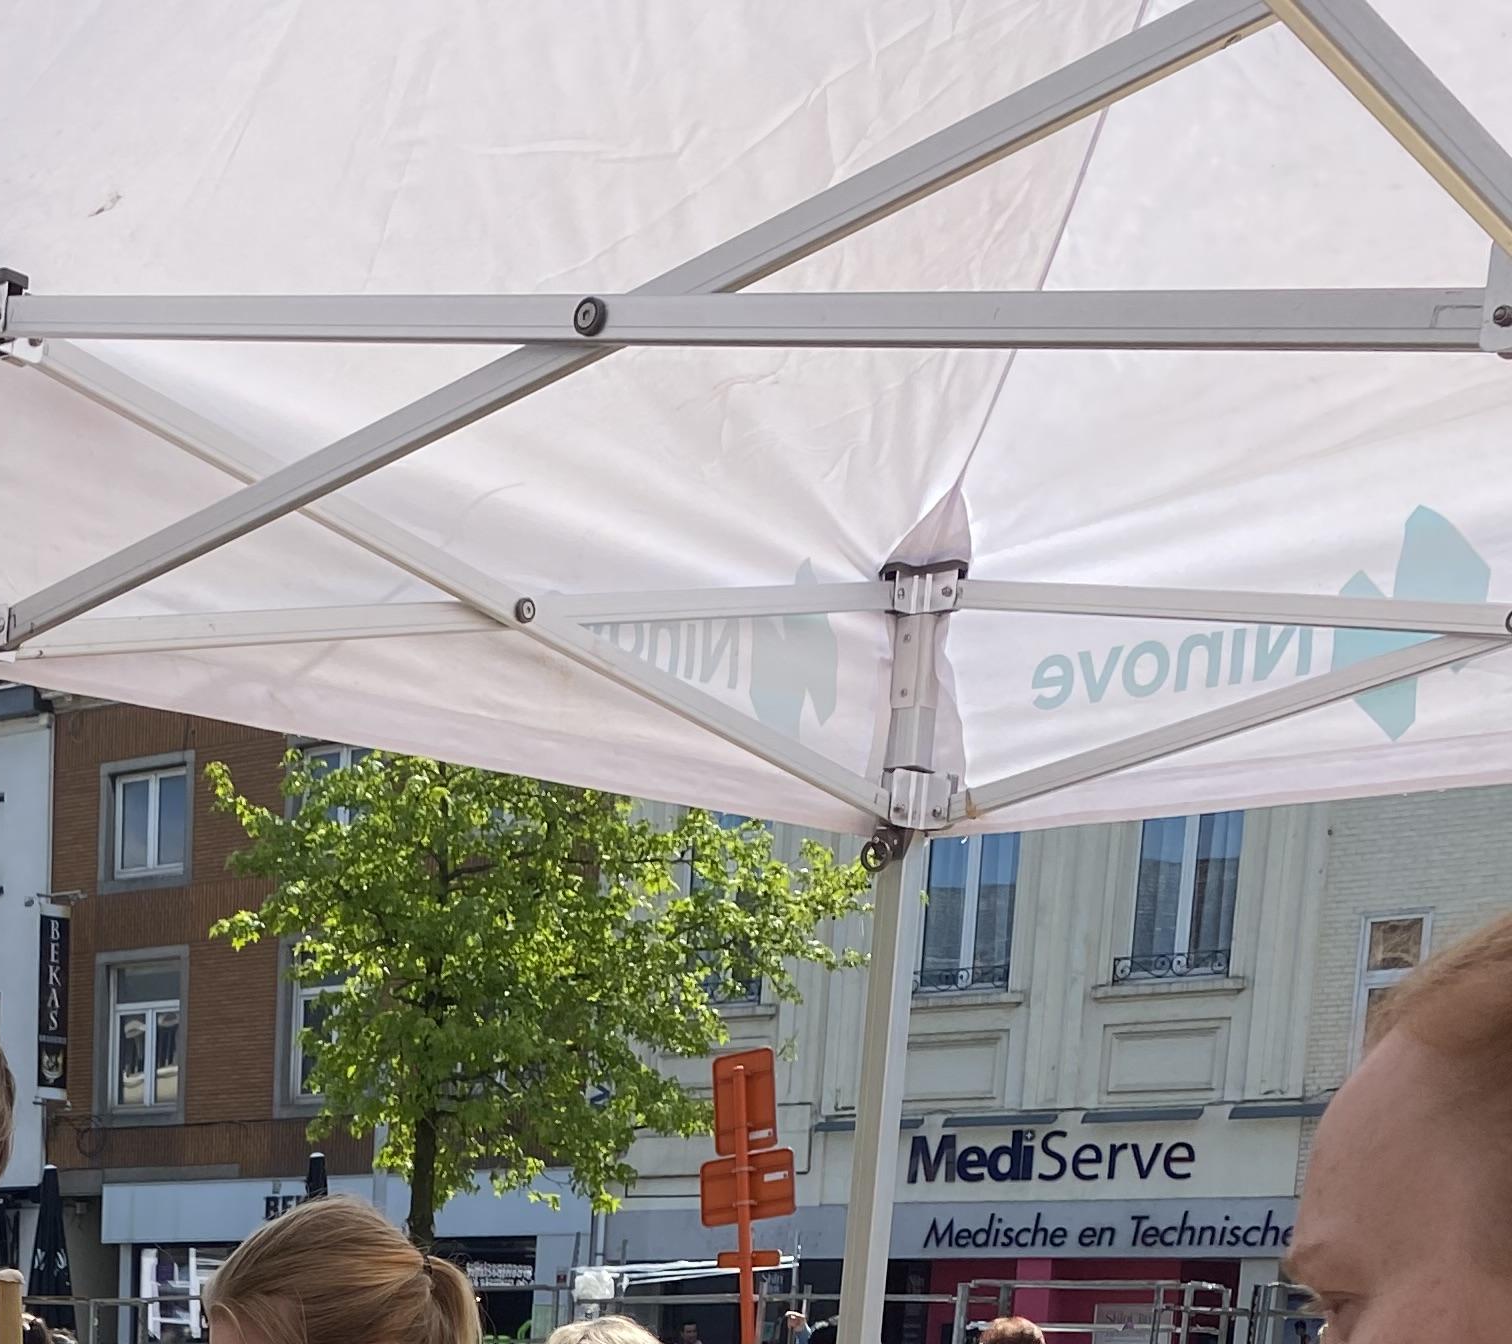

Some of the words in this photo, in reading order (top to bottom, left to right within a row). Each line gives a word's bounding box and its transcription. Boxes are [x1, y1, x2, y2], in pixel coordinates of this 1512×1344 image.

[46, 919, 62, 1031] BEKAS
[907, 1129, 1196, 1185] MediServe
[923, 1212, 1068, 1249] Medische
[1078, 1222, 1116, 1248] en
[1130, 1210, 1293, 1248] Technische
